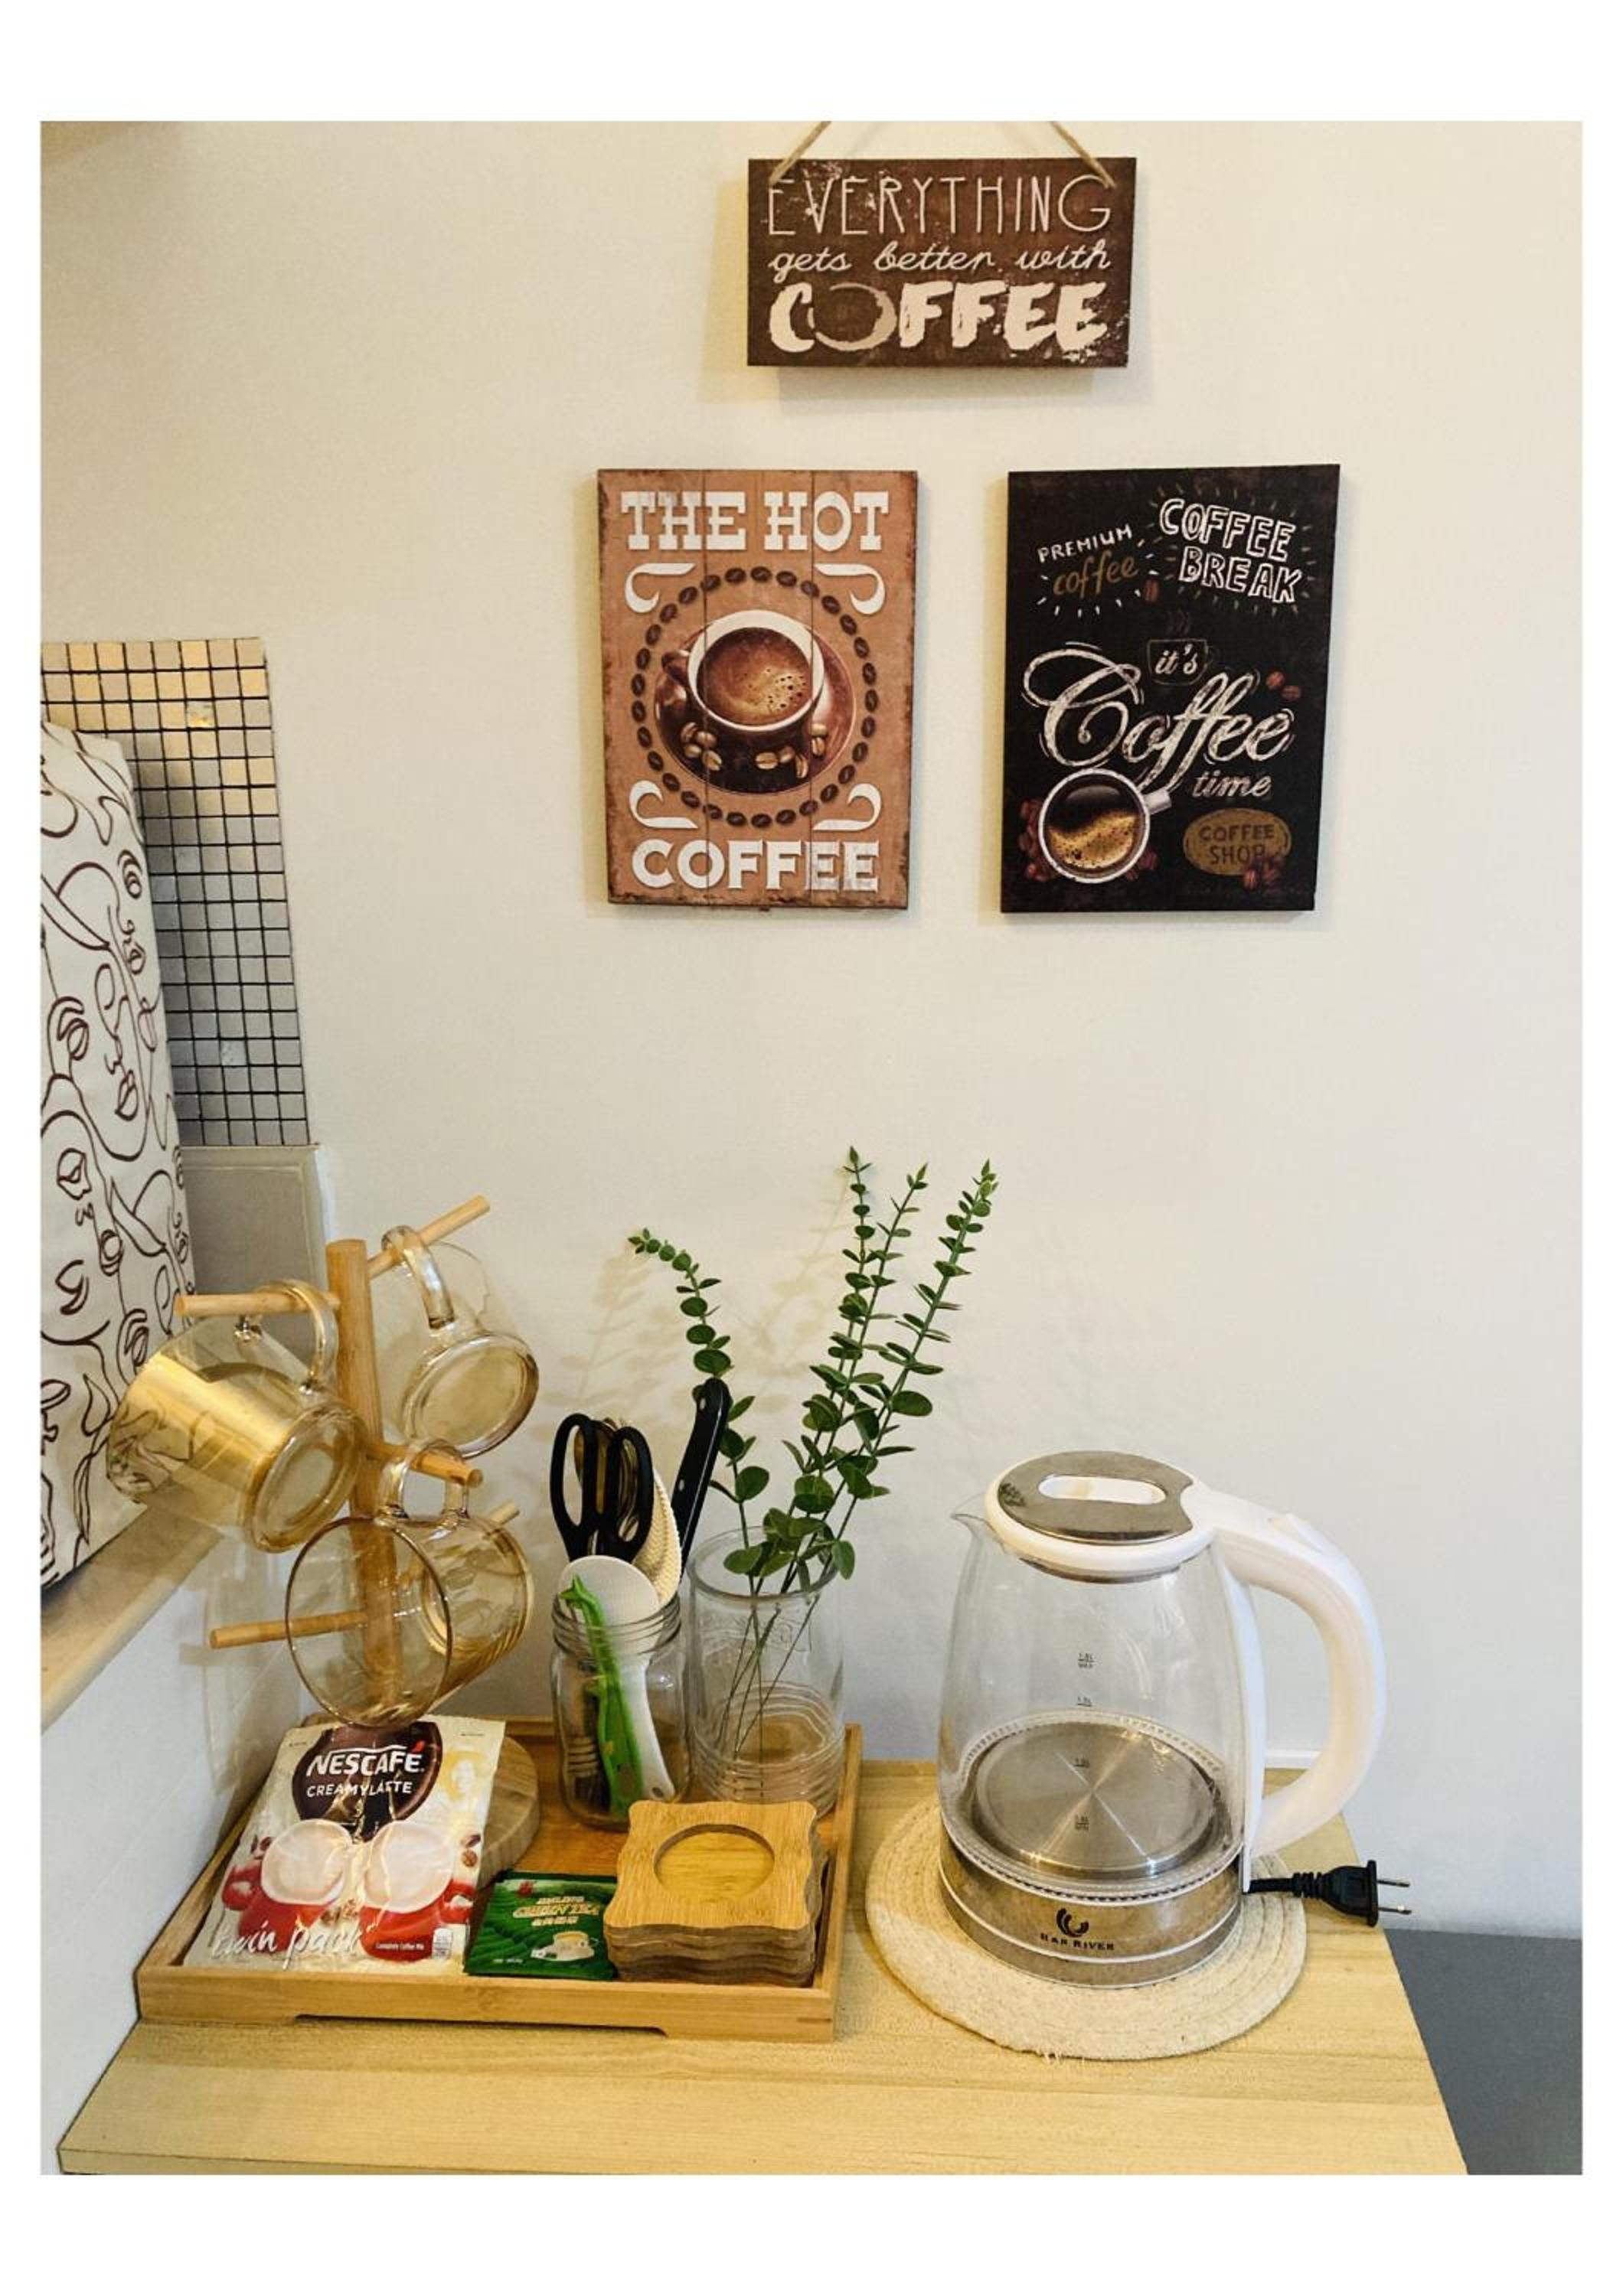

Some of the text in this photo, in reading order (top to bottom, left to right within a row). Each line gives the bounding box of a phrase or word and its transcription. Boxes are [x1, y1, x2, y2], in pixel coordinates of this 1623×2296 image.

[769, 169, 1112, 236] EVERYTHING
[768, 238, 1112, 283] gets better with
[769, 280, 1109, 353] COFFEE
[620, 491, 890, 553] THE HOT
[1037, 523, 1133, 563] PREMIUM
[1159, 498, 1296, 562] COFFEE
[1053, 550, 1139, 599] coffee
[1178, 546, 1302, 605] BREAK
[1154, 643, 1199, 675] it's
[1023, 647, 1294, 793] Coffee
[1192, 769, 1272, 797] time
[1199, 823, 1275, 842] COFFEE
[1209, 844, 1266, 866] SHOP
[631, 838, 880, 892] COFFEE
